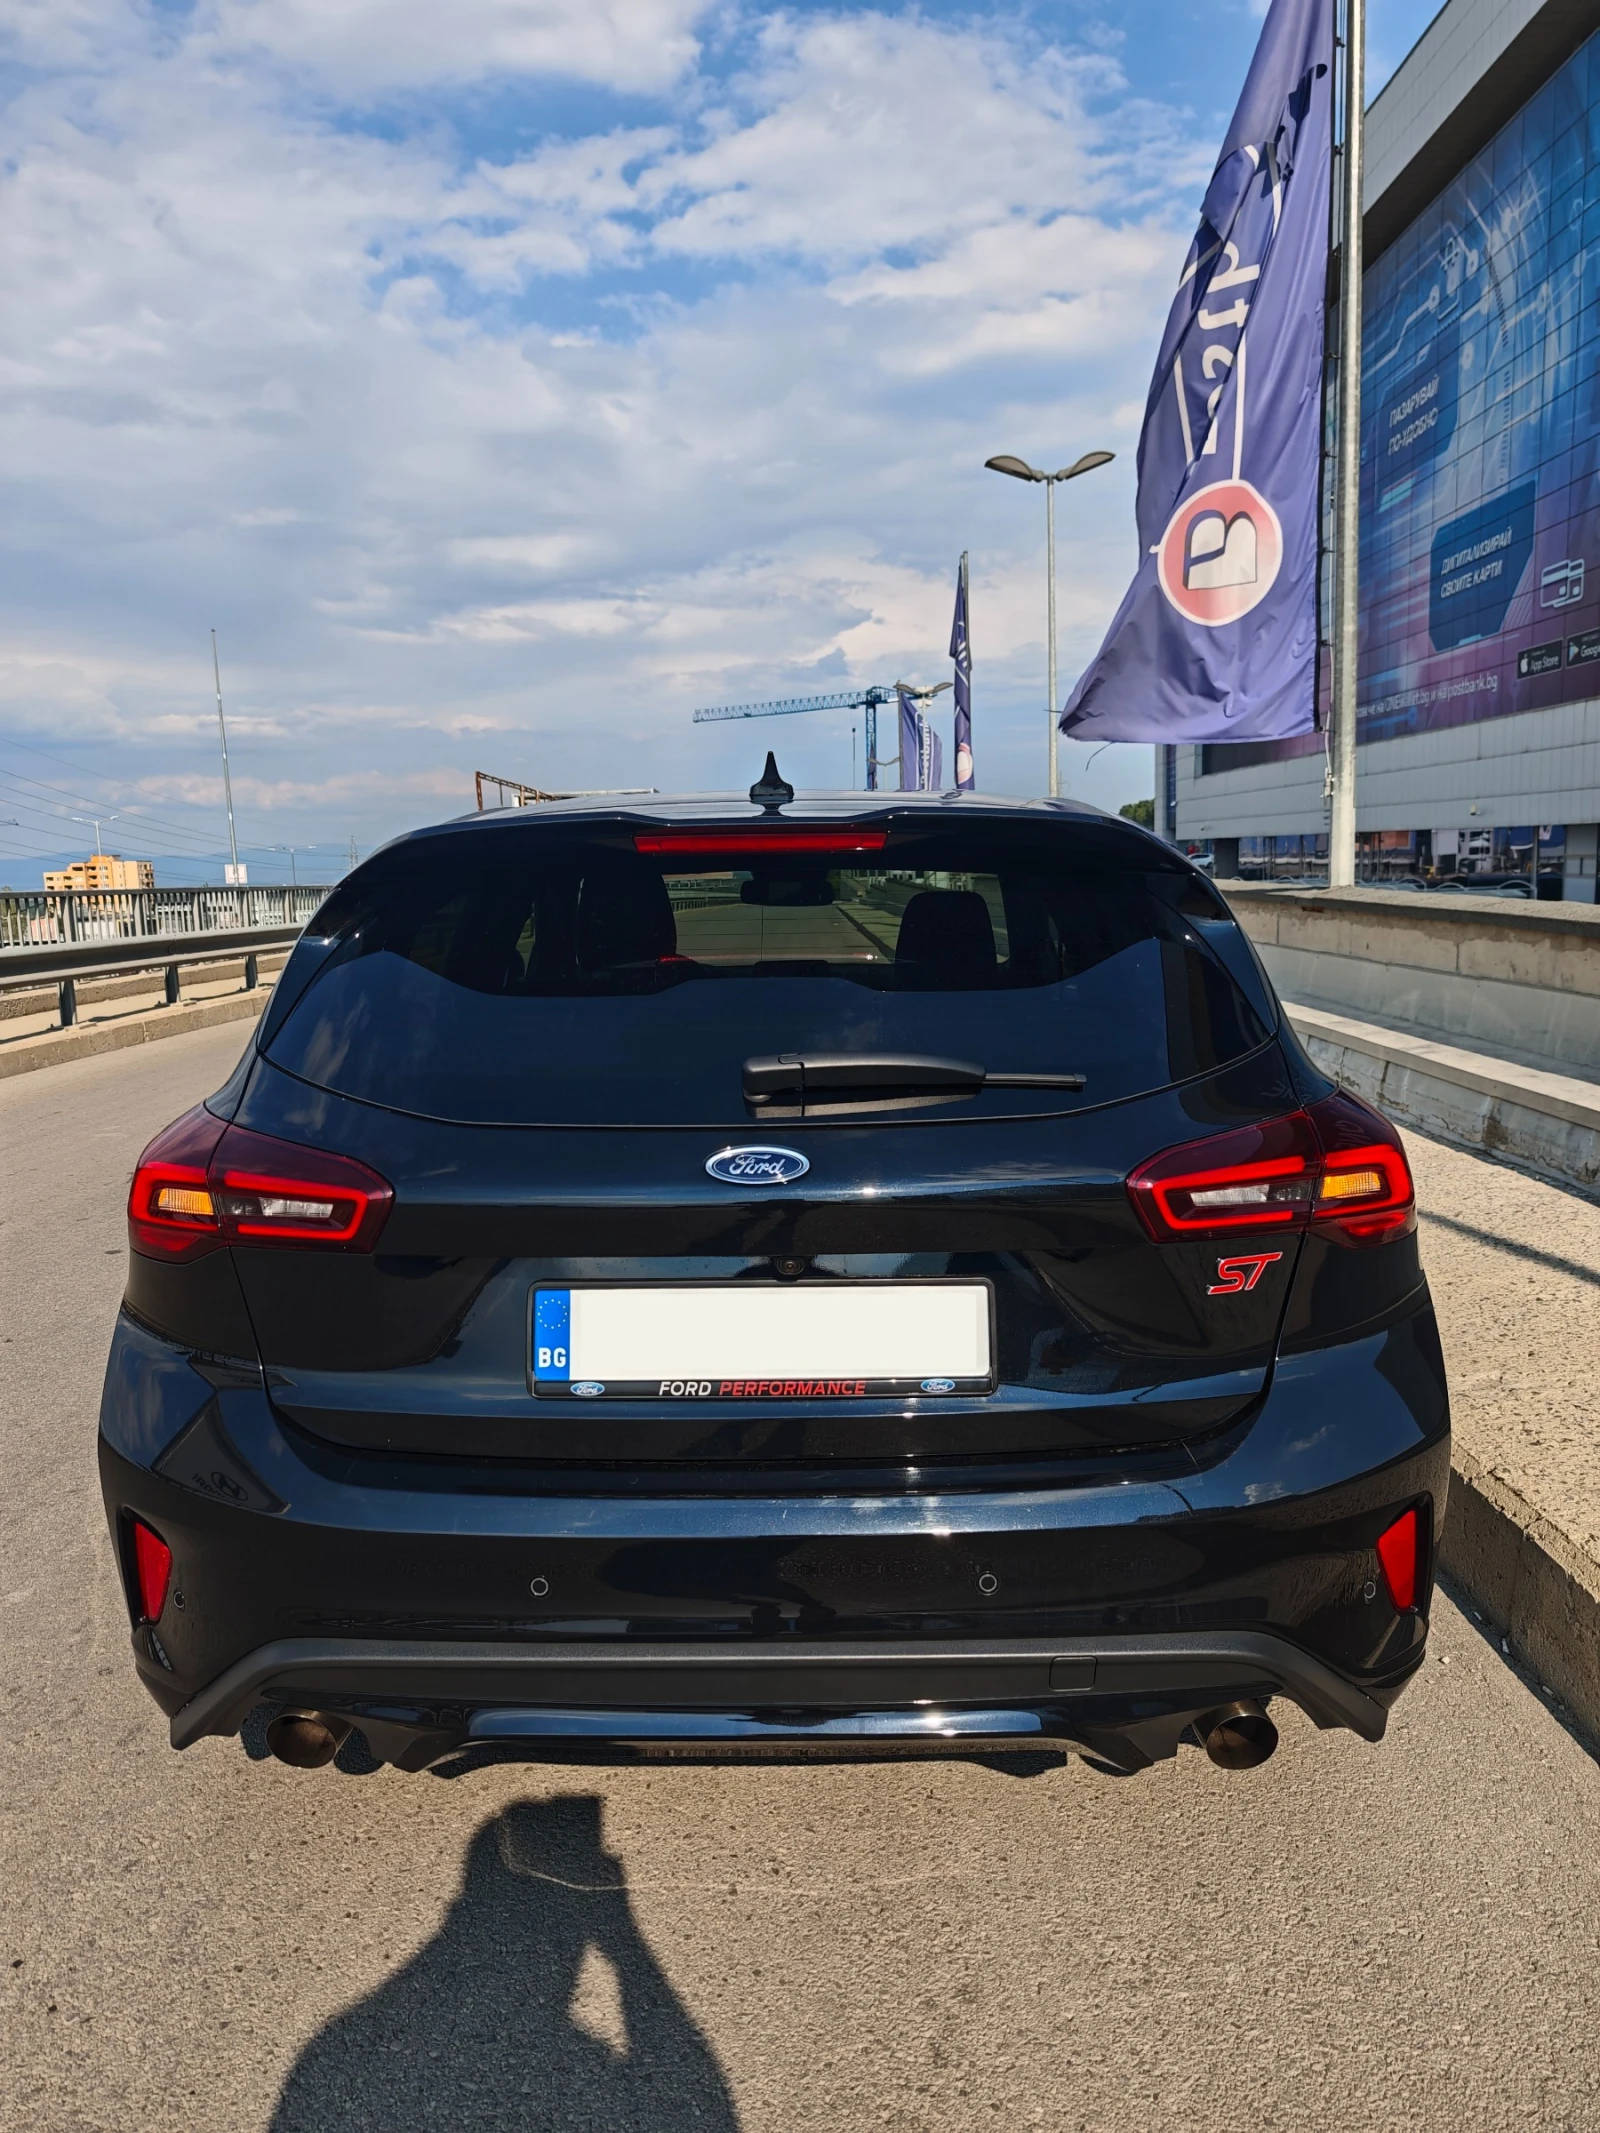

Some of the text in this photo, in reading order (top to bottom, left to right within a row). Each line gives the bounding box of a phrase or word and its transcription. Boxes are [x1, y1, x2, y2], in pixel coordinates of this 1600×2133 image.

[1441, 525, 1512, 576] ДИГИТАЛИЗИРАЙ
[1441, 559, 1503, 598] СВОИТЕ КАРТИ
[1530, 656, 1559, 672] App Store
[1448, 671, 1498, 702] postbank.bg
[728, 1154, 785, 1176] Ford
[1207, 1252, 1283, 1295] ST
[538, 1347, 567, 1368] BG
[573, 1383, 602, 1395] Ford
[658, 1380, 867, 1396] FORD PERFORMANCE
[924, 1379, 952, 1392] Ford
